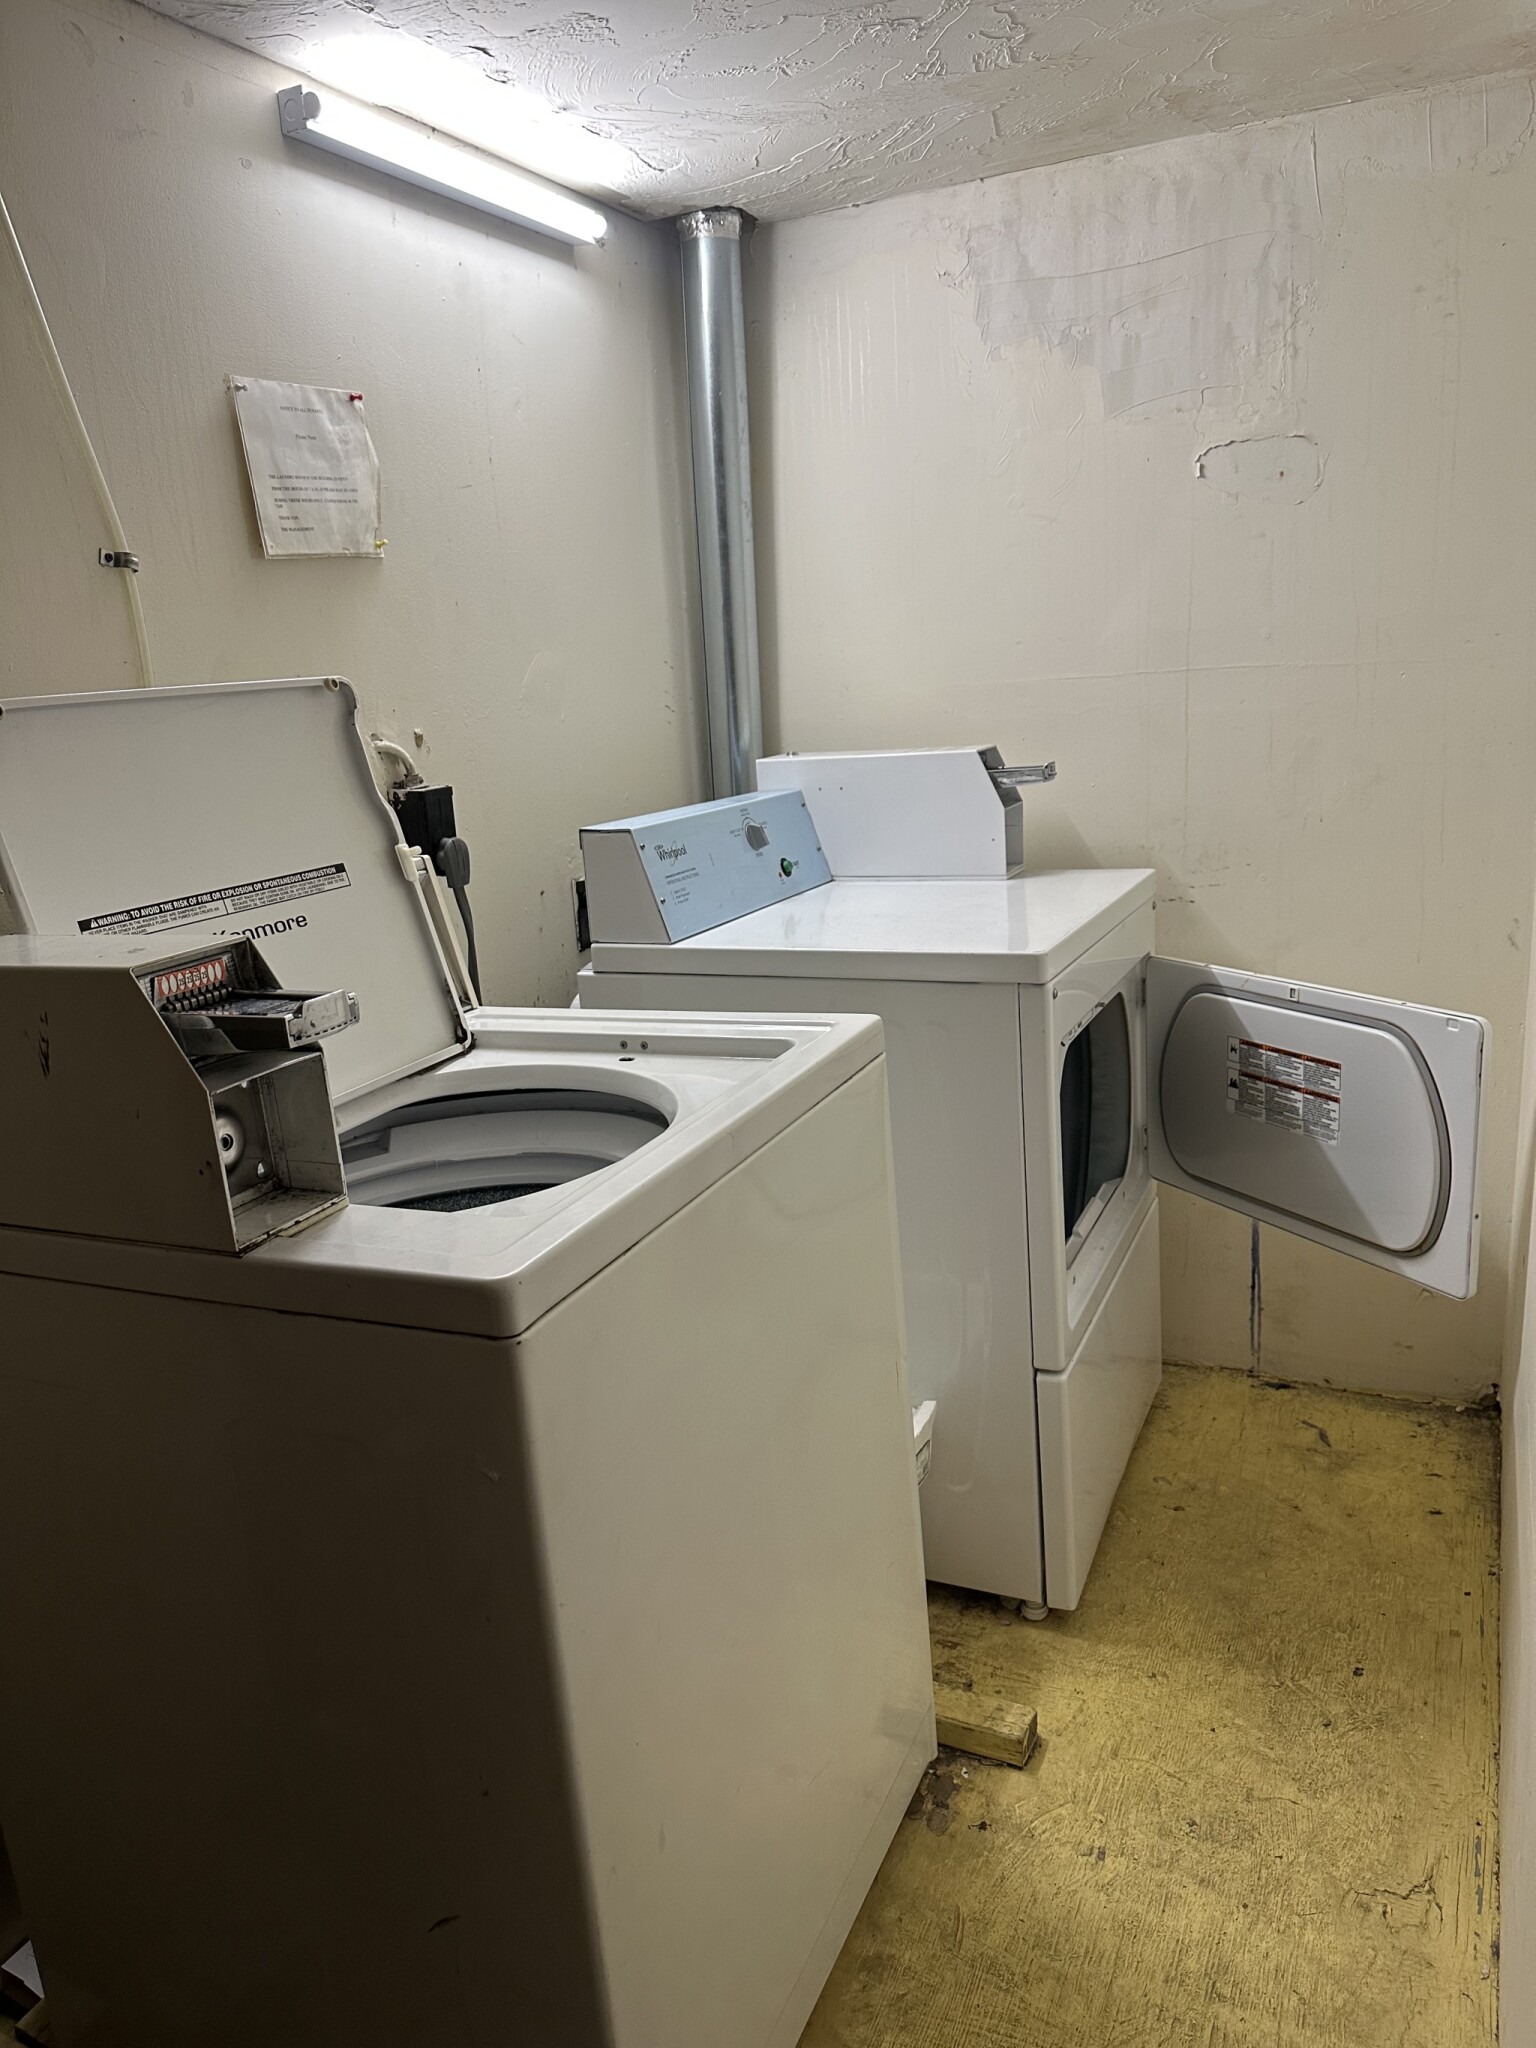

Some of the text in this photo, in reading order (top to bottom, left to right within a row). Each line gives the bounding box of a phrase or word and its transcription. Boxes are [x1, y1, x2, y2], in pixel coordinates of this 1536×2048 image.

[657, 843, 688, 862] Whirlpool
[96, 866, 336, 926] WARNING: TO AVOID THE RISK OF FIRE OR EXPLOSION OR SPONTANEOUS COMBUSTION
[212, 914, 308, 940] nmore
[178, 970, 208, 986] 25 25 25 25
